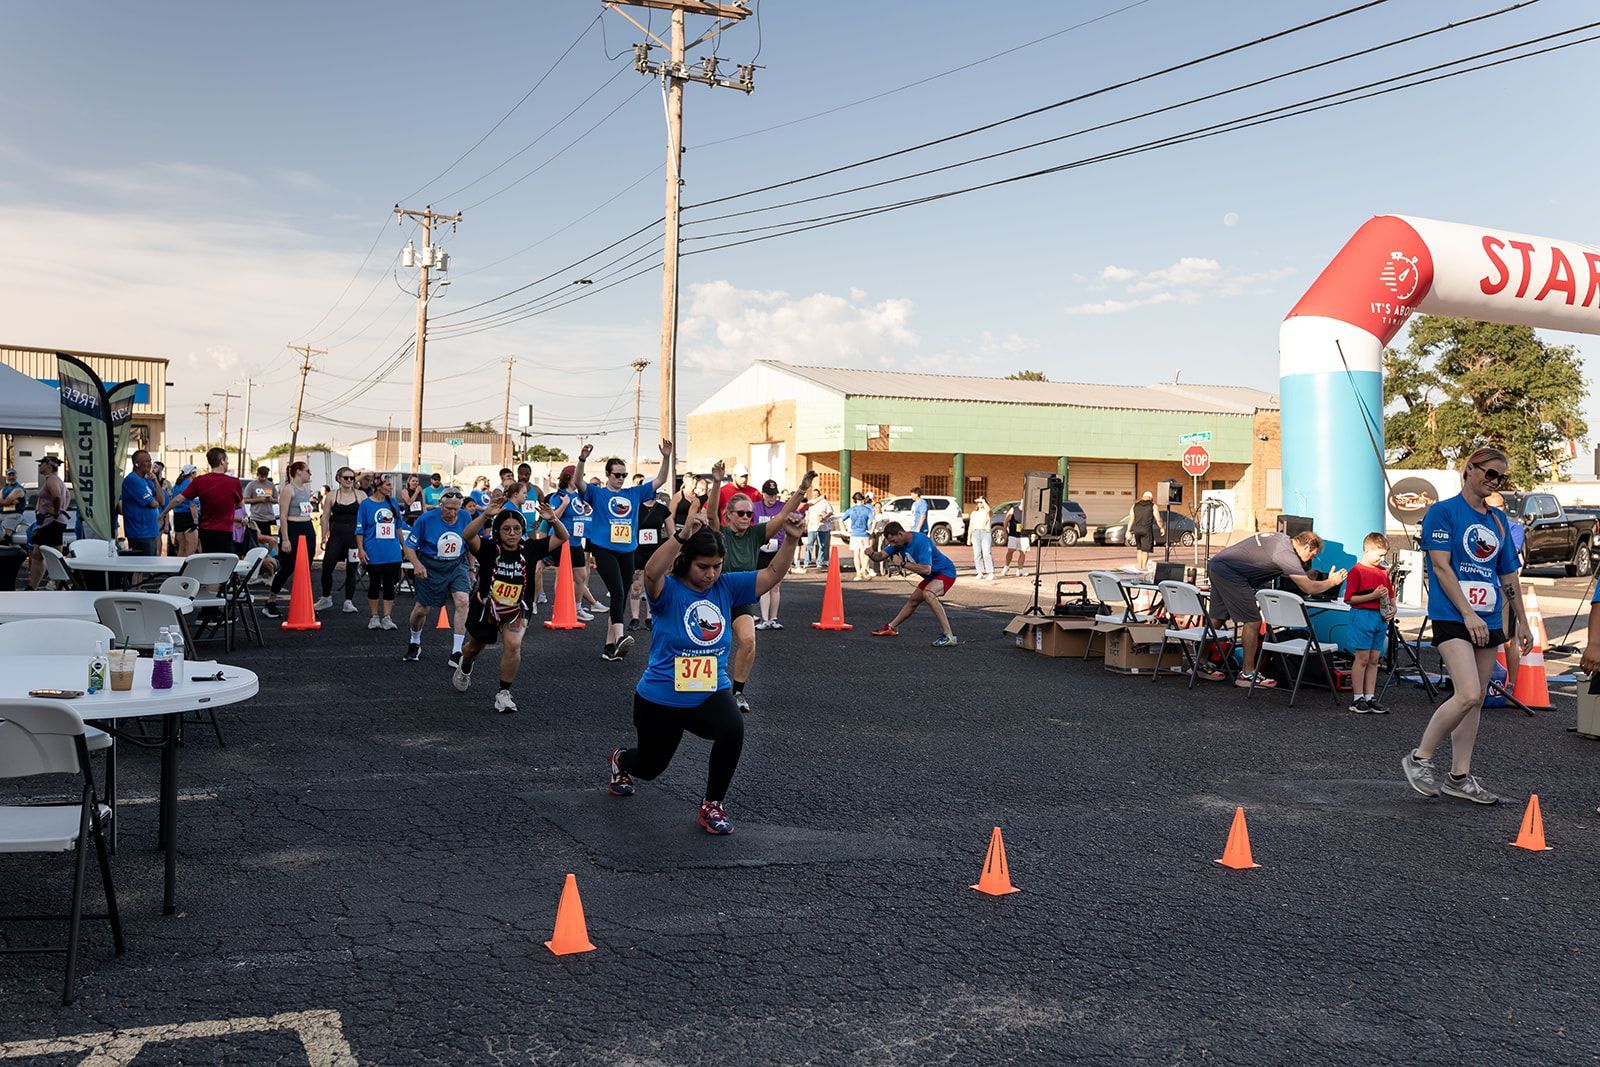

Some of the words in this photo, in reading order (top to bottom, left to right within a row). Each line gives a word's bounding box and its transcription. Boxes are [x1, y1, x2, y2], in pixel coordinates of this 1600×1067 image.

[1371, 302, 1391, 315] IT'S
[1394, 305, 1412, 317] ABO
[1184, 454, 1208, 467] STOP
[525, 501, 534, 510] 24
[381, 526, 391, 536] 38
[614, 526, 630, 537] 373
[643, 532, 653, 541] 56
[444, 543, 456, 554] 26
[496, 583, 519, 599] 403
[1469, 587, 1487, 605] 52
[681, 658, 713, 679] 374
